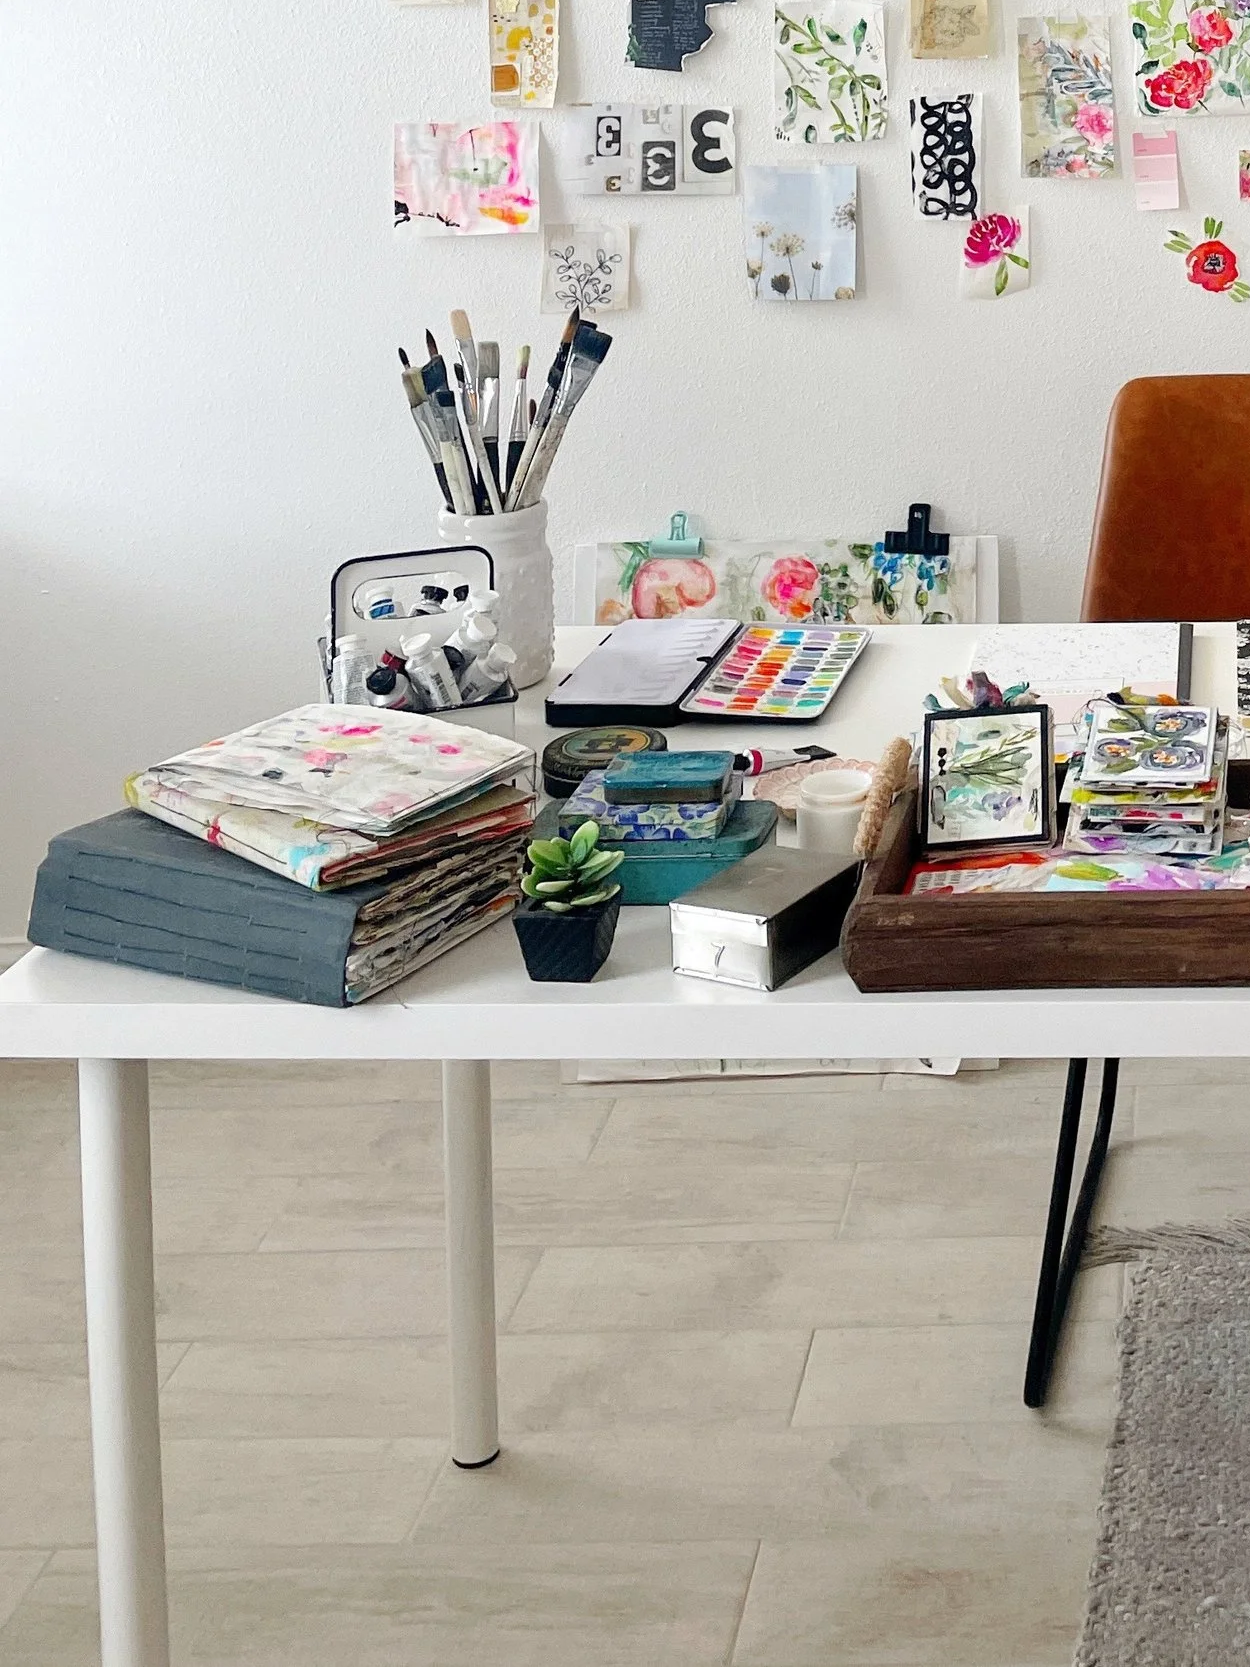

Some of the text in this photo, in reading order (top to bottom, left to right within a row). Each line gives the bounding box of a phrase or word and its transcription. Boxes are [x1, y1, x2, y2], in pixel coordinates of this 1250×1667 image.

[597, 117, 620, 156] 3
[690, 109, 733, 174] 3
[646, 146, 672, 186] 3
